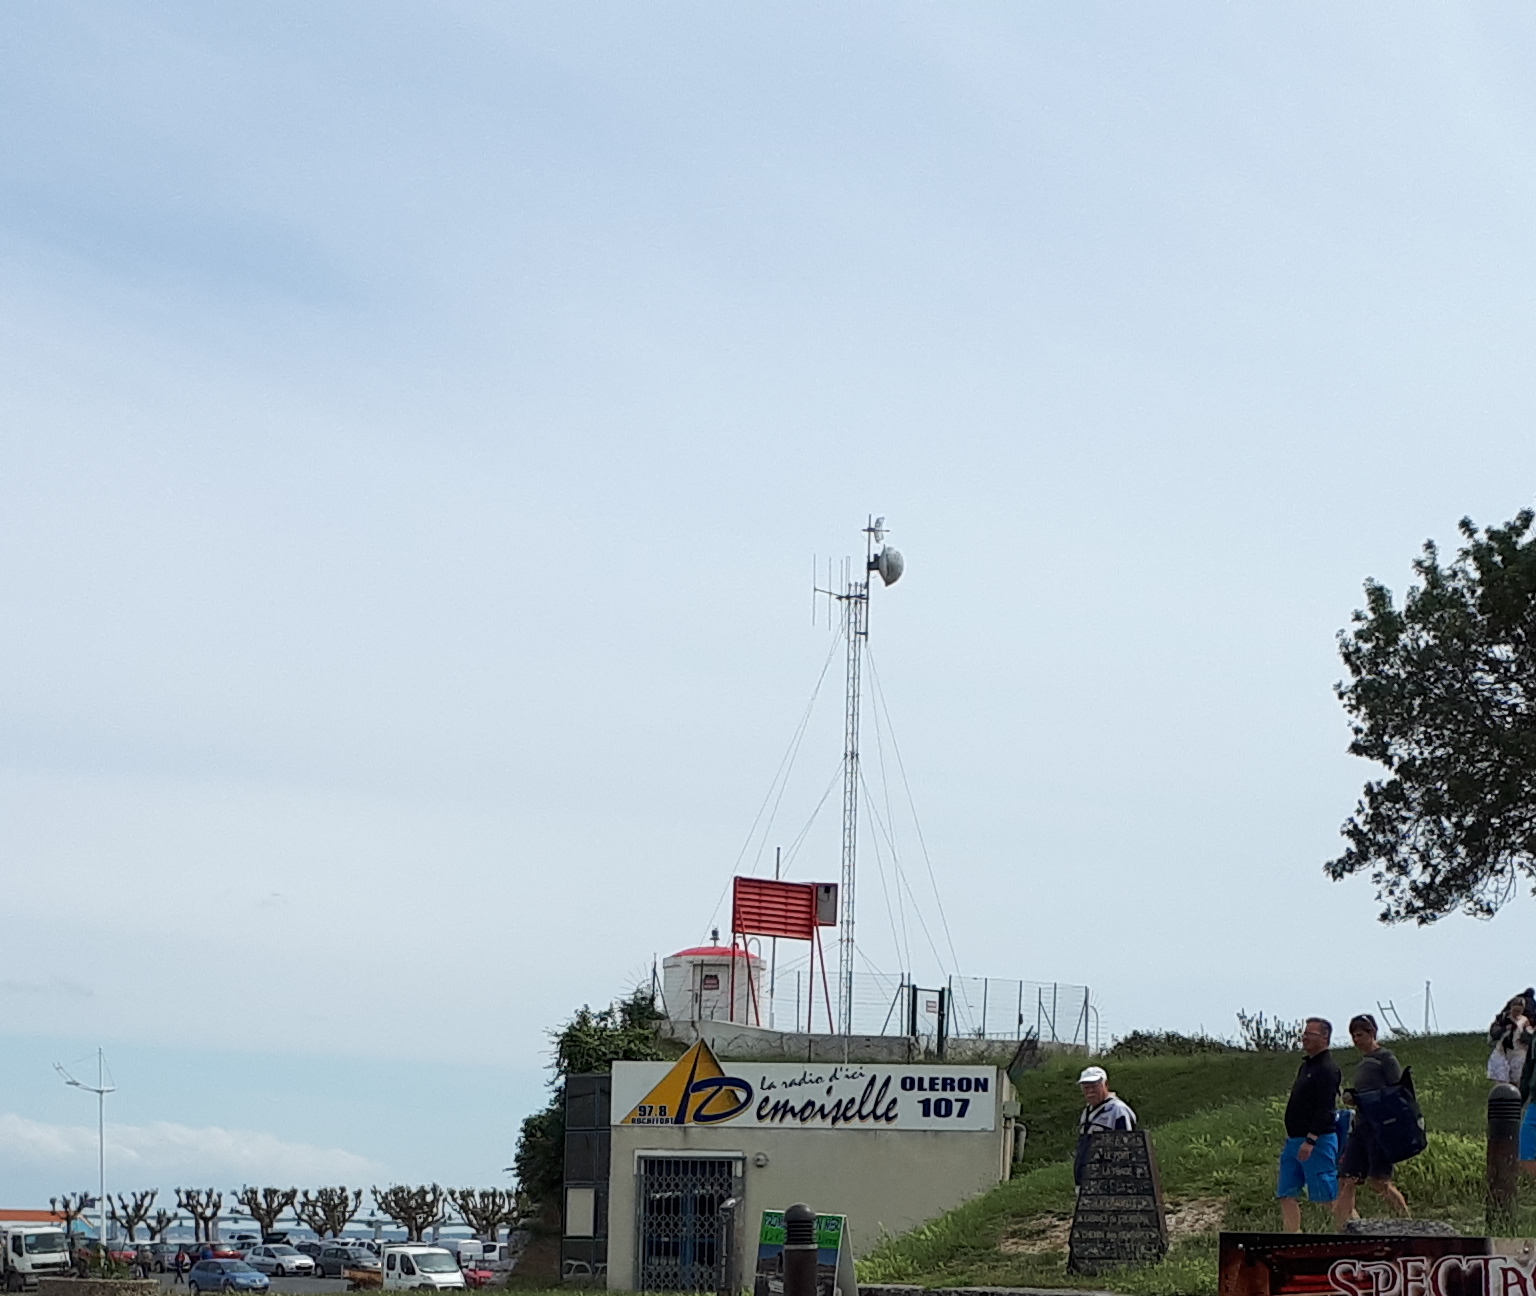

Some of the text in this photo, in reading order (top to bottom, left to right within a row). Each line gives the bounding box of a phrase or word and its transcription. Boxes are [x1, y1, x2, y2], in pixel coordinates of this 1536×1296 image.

[760, 1066, 865, 1090] la radio d'ici
[900, 1076, 989, 1093] OLERON
[638, 1105, 667, 1117] 97.8
[917, 1098, 971, 1118] 107
